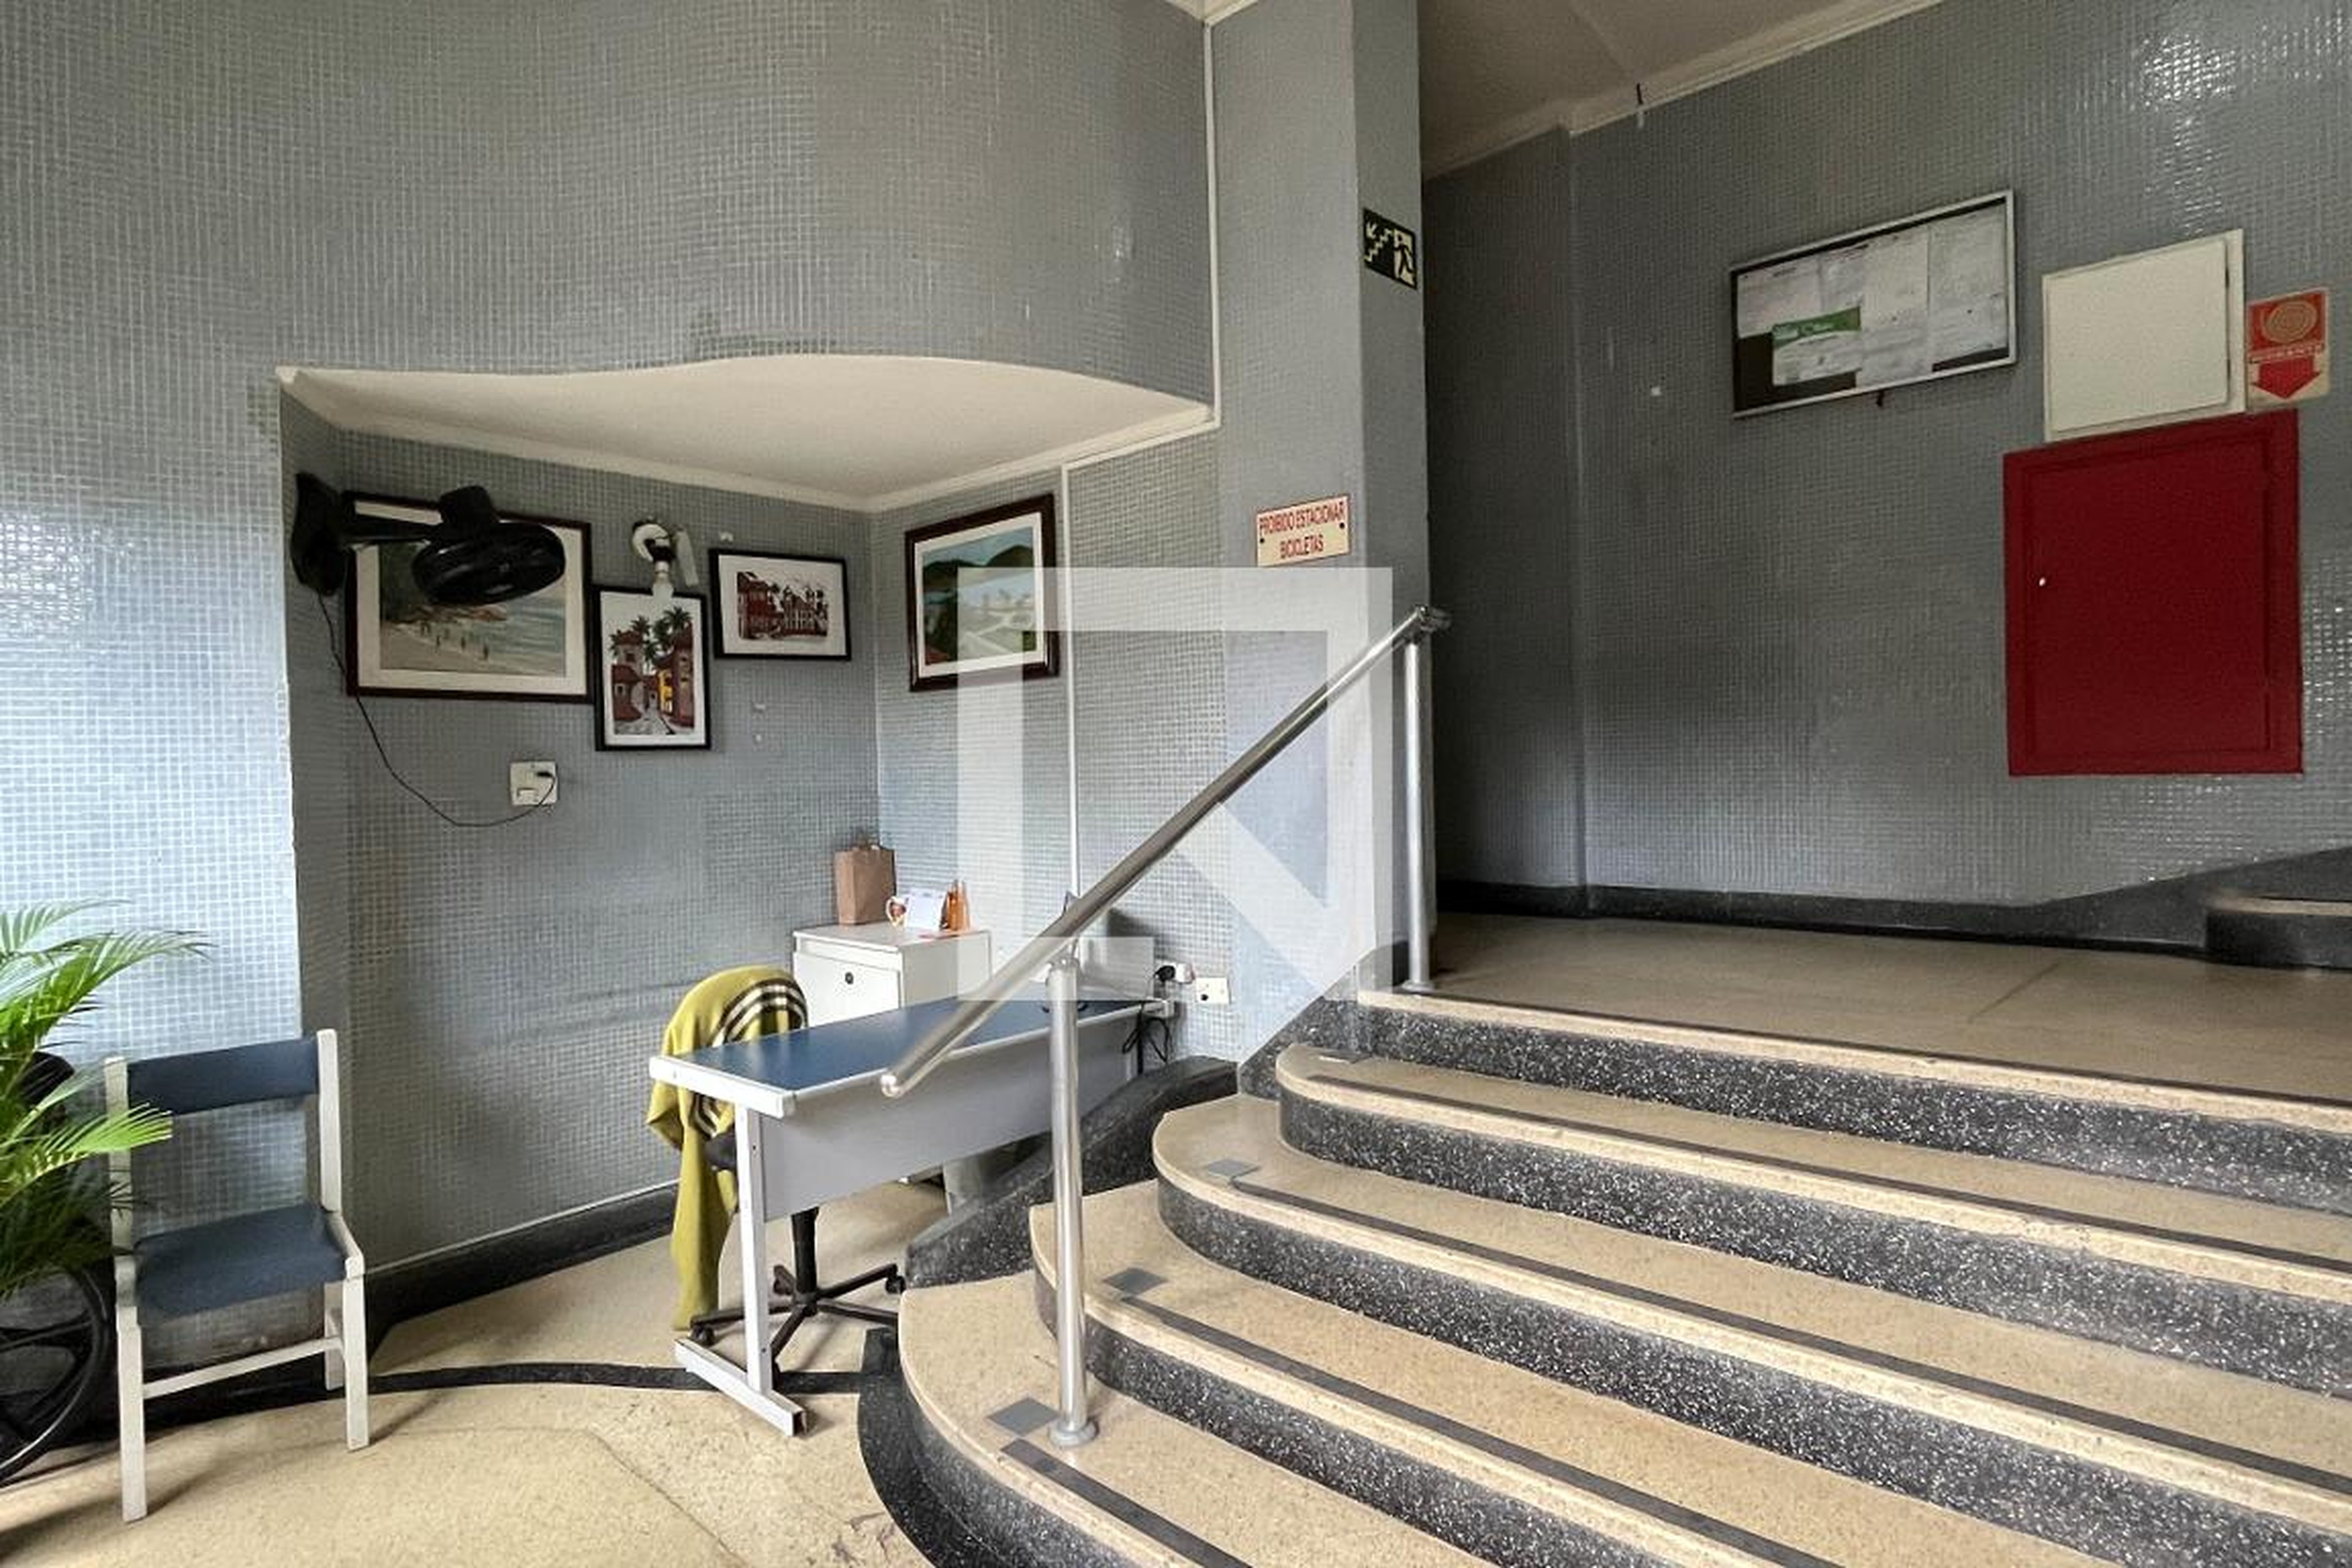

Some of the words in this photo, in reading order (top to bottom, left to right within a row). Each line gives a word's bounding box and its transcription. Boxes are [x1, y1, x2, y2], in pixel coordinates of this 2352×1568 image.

[1260, 510, 1294, 535] PROIBIDO
[1296, 500, 1344, 528] ESTACIONAR
[1280, 533, 1323, 559] BICICLETAS
